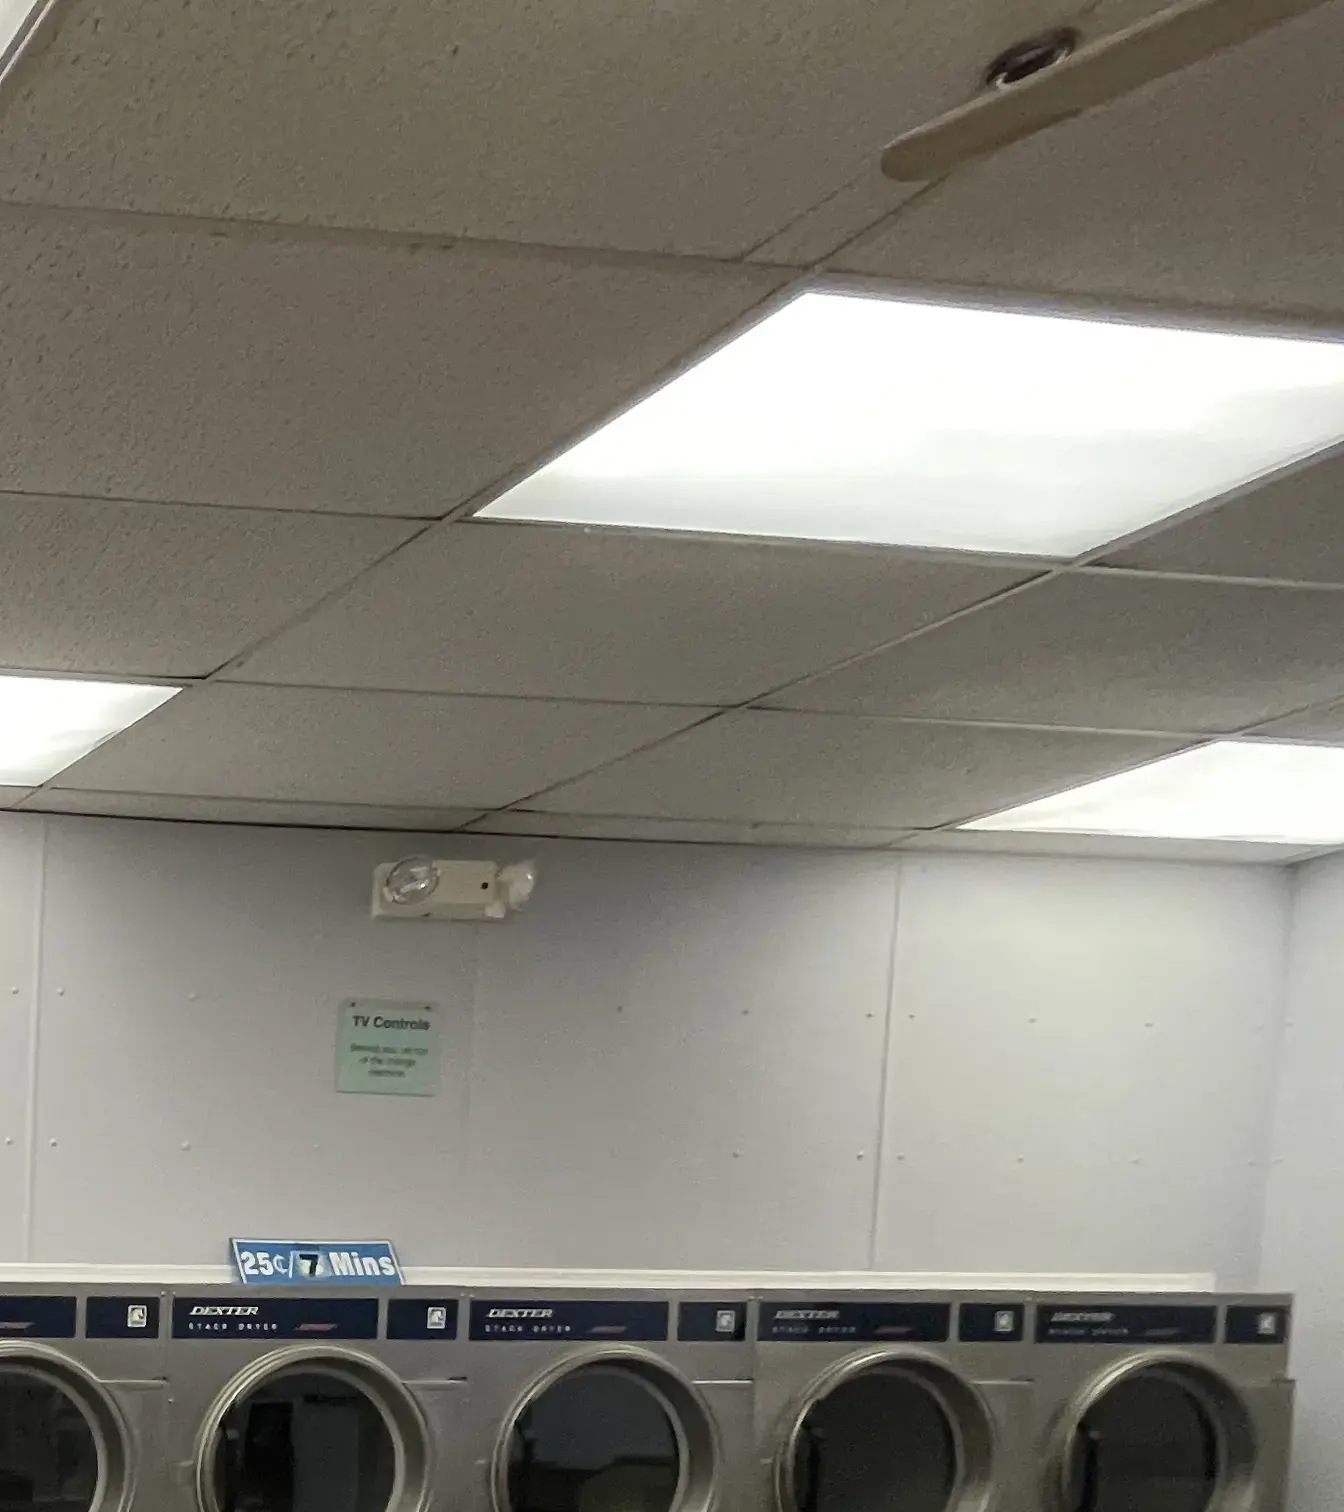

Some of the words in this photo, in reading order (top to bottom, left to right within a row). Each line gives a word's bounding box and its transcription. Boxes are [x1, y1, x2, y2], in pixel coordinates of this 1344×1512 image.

[353, 1015, 370, 1027] TV
[328, 1251, 396, 1276] Mins
[189, 1306, 260, 1316] DEXTER
[486, 1308, 553, 1318] DEXTER
